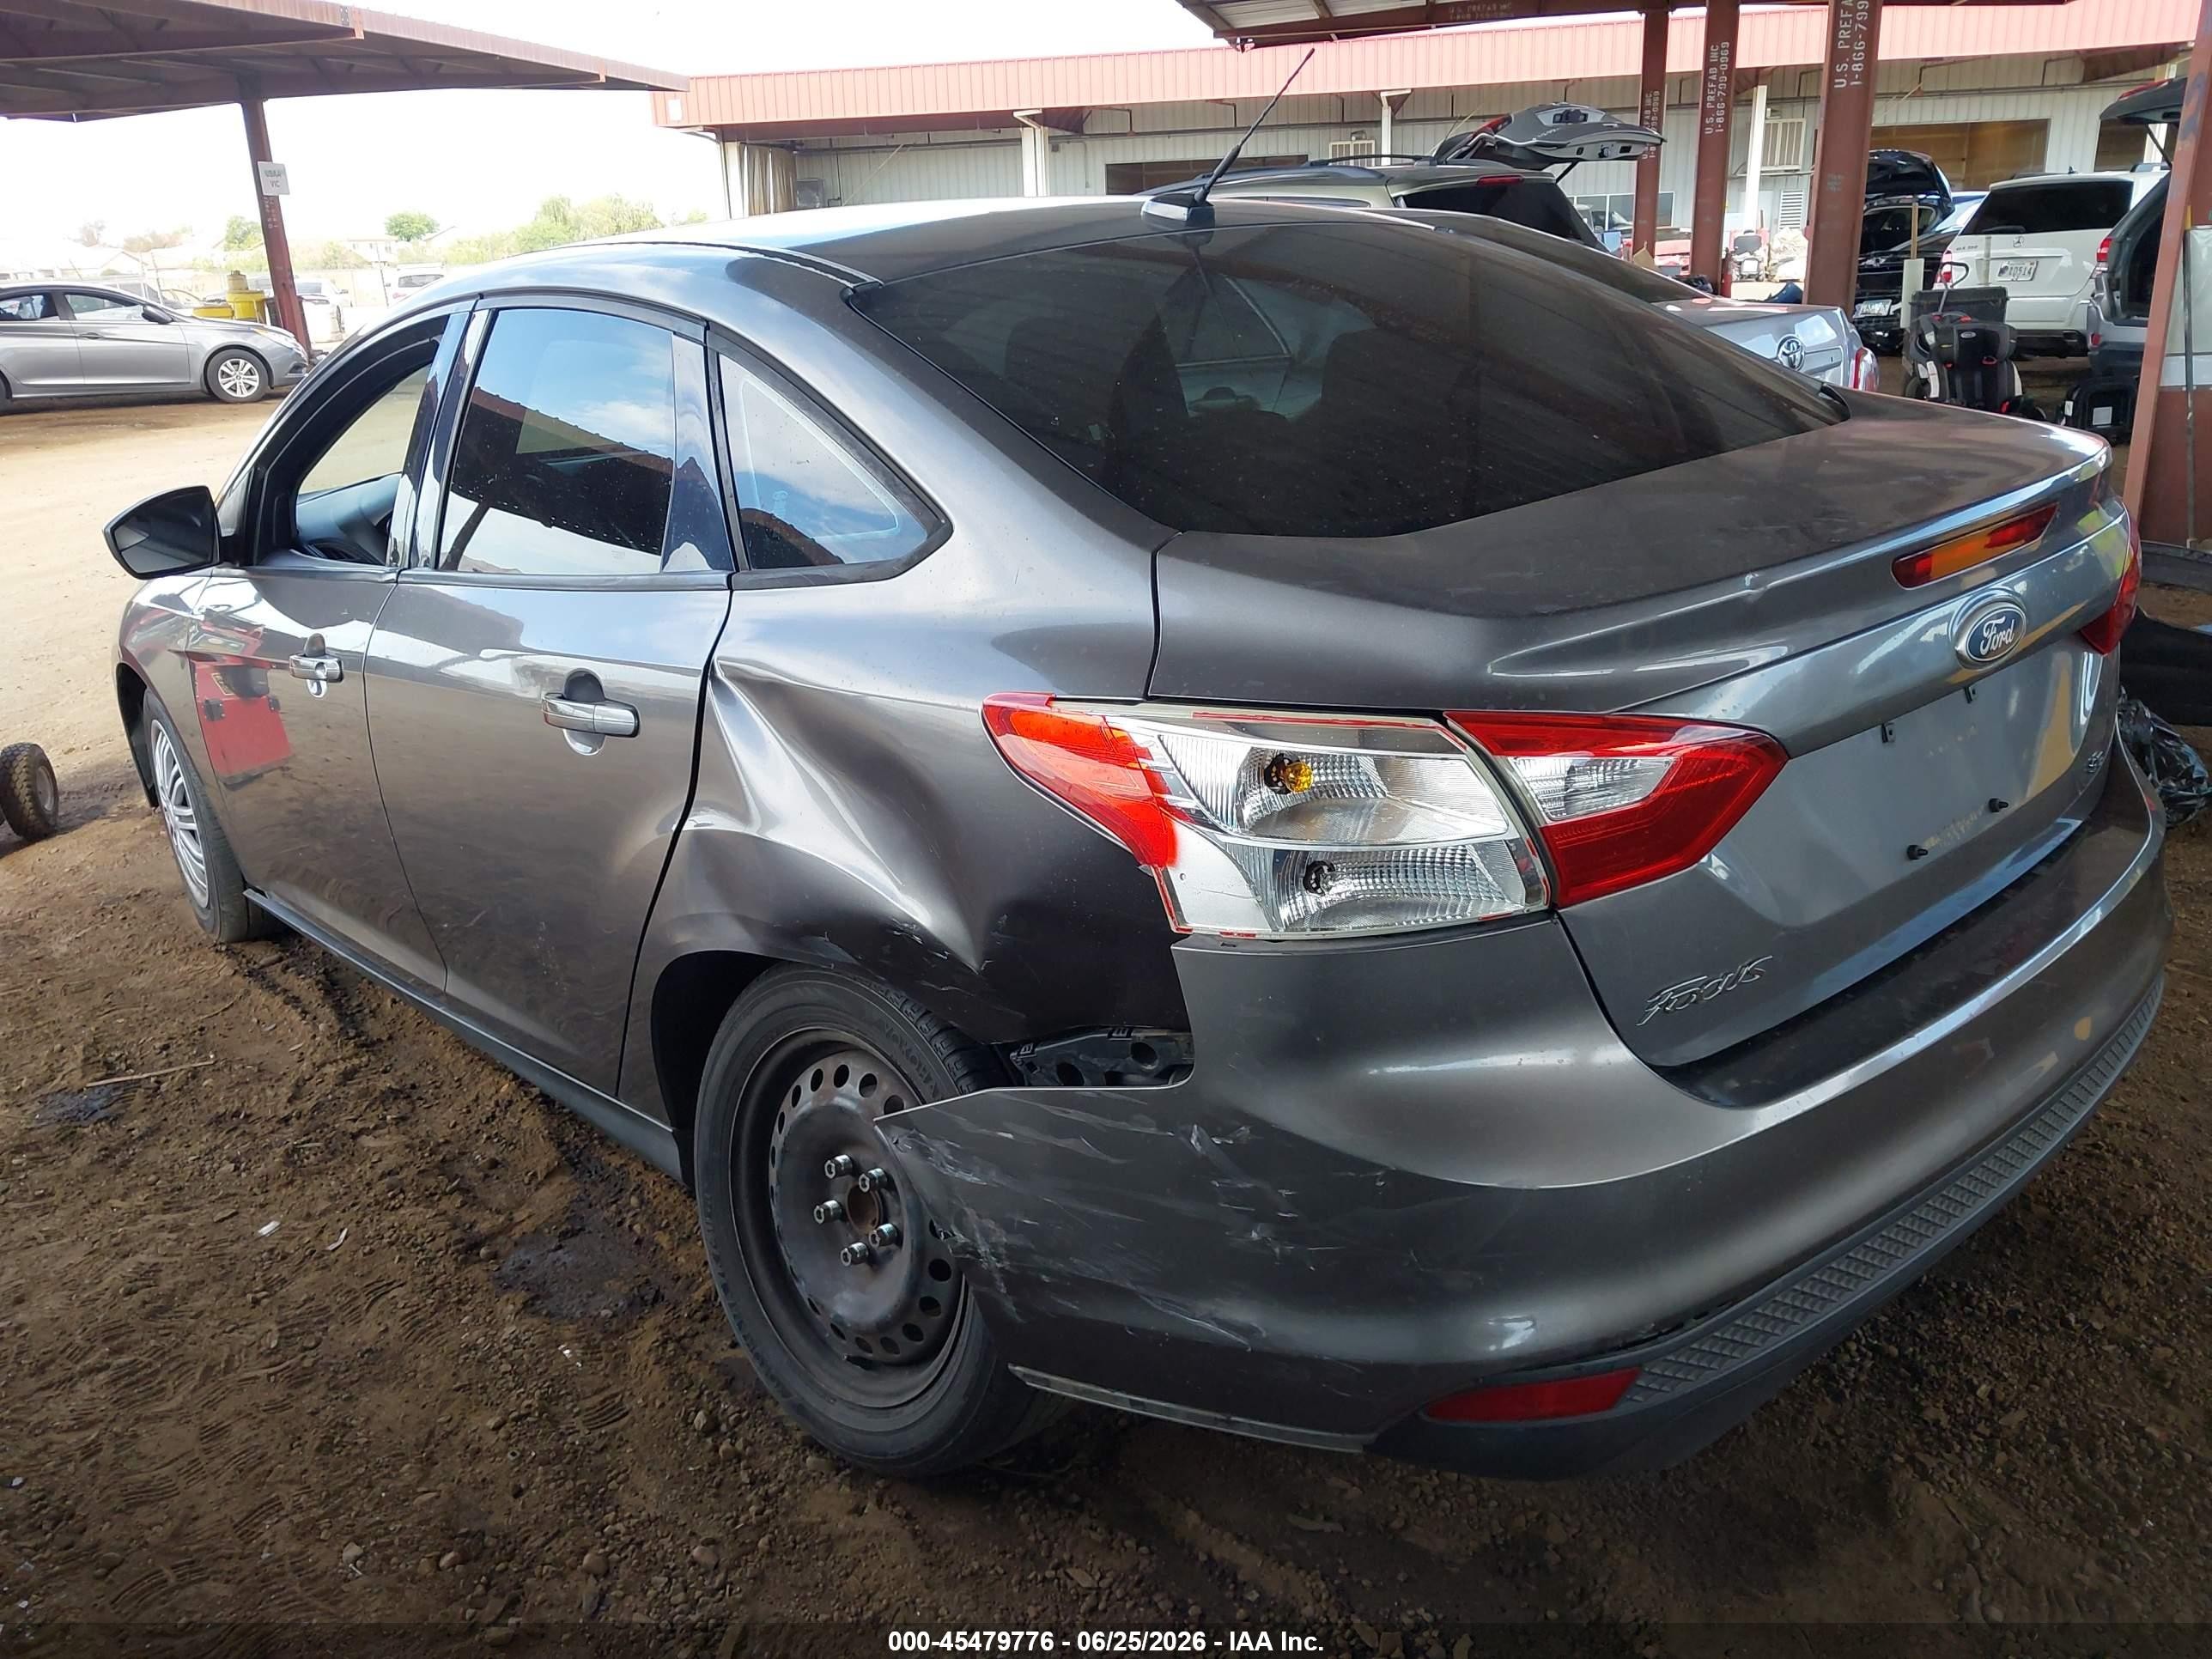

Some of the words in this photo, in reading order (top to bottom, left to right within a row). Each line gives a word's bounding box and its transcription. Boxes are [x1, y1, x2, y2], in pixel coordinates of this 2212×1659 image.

[1706, 67, 1718, 109] PREFAB
[1833, 58, 1849, 88] U.S.
[1705, 113, 1716, 135] U.S.
[1979, 615, 2015, 656] Ford
[1635, 955, 1773, 1026] Focus
